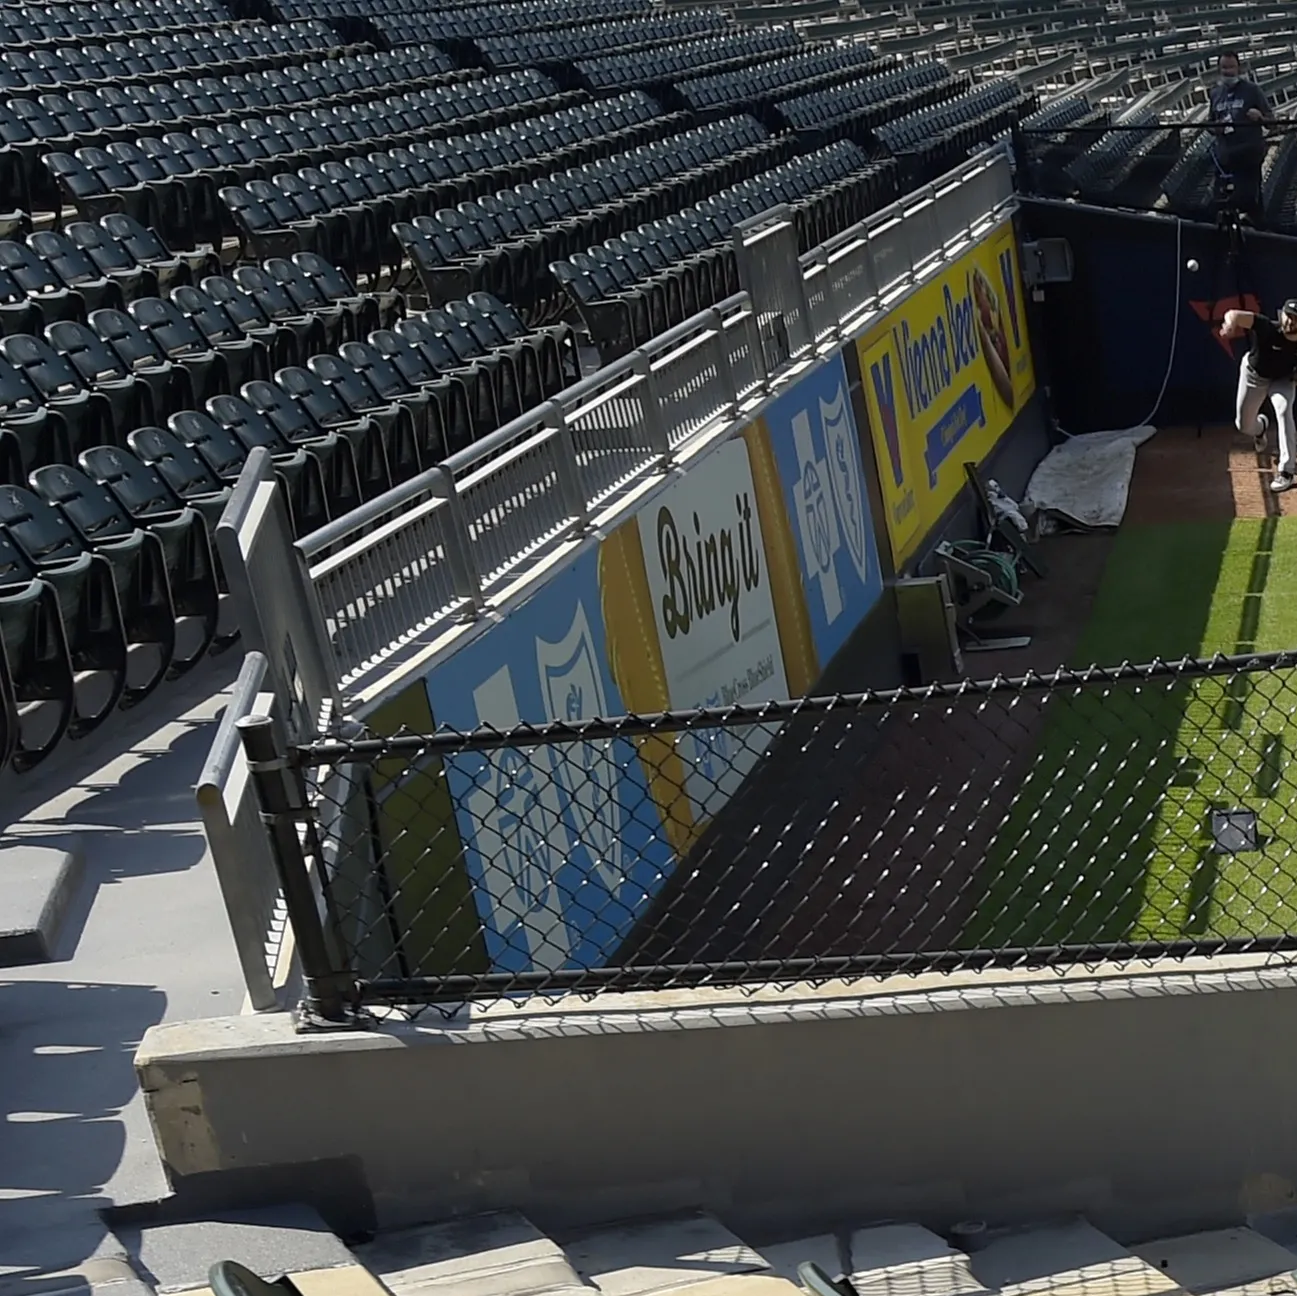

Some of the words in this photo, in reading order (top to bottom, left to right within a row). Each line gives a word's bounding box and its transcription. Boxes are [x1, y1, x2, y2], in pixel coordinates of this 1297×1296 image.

[892, 315, 950, 419] Vienna
[943, 271, 979, 375] Beef
[657, 505, 740, 643] Bring
[735, 492, 760, 592] it
